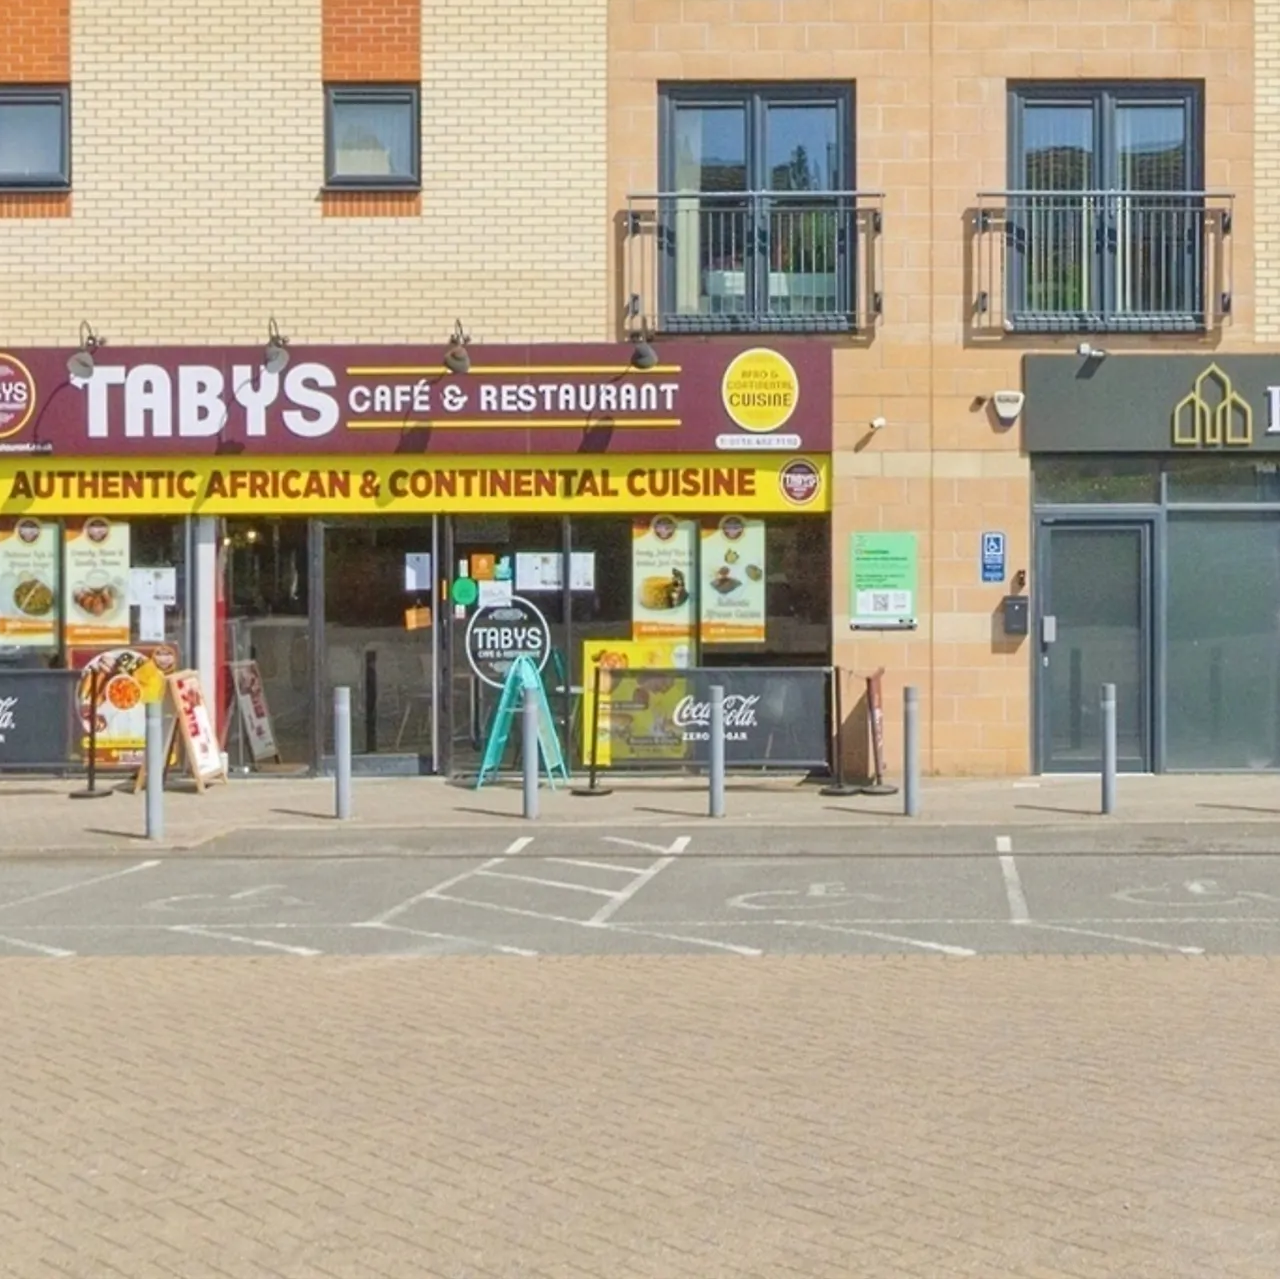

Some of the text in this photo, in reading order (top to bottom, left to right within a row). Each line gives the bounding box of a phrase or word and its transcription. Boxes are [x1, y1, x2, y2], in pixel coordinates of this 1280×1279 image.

[70, 363, 340, 437] TABYS
[348, 379, 679, 412] CAFÉ & RESTAURANT
[729, 392, 792, 407] CUISINE
[9, 468, 756, 498] AUTHENTIC AFRICAN & CONTINENTAL CUISINE
[473, 627, 542, 649] TABYS
[682, 732, 711, 741] ZERO
